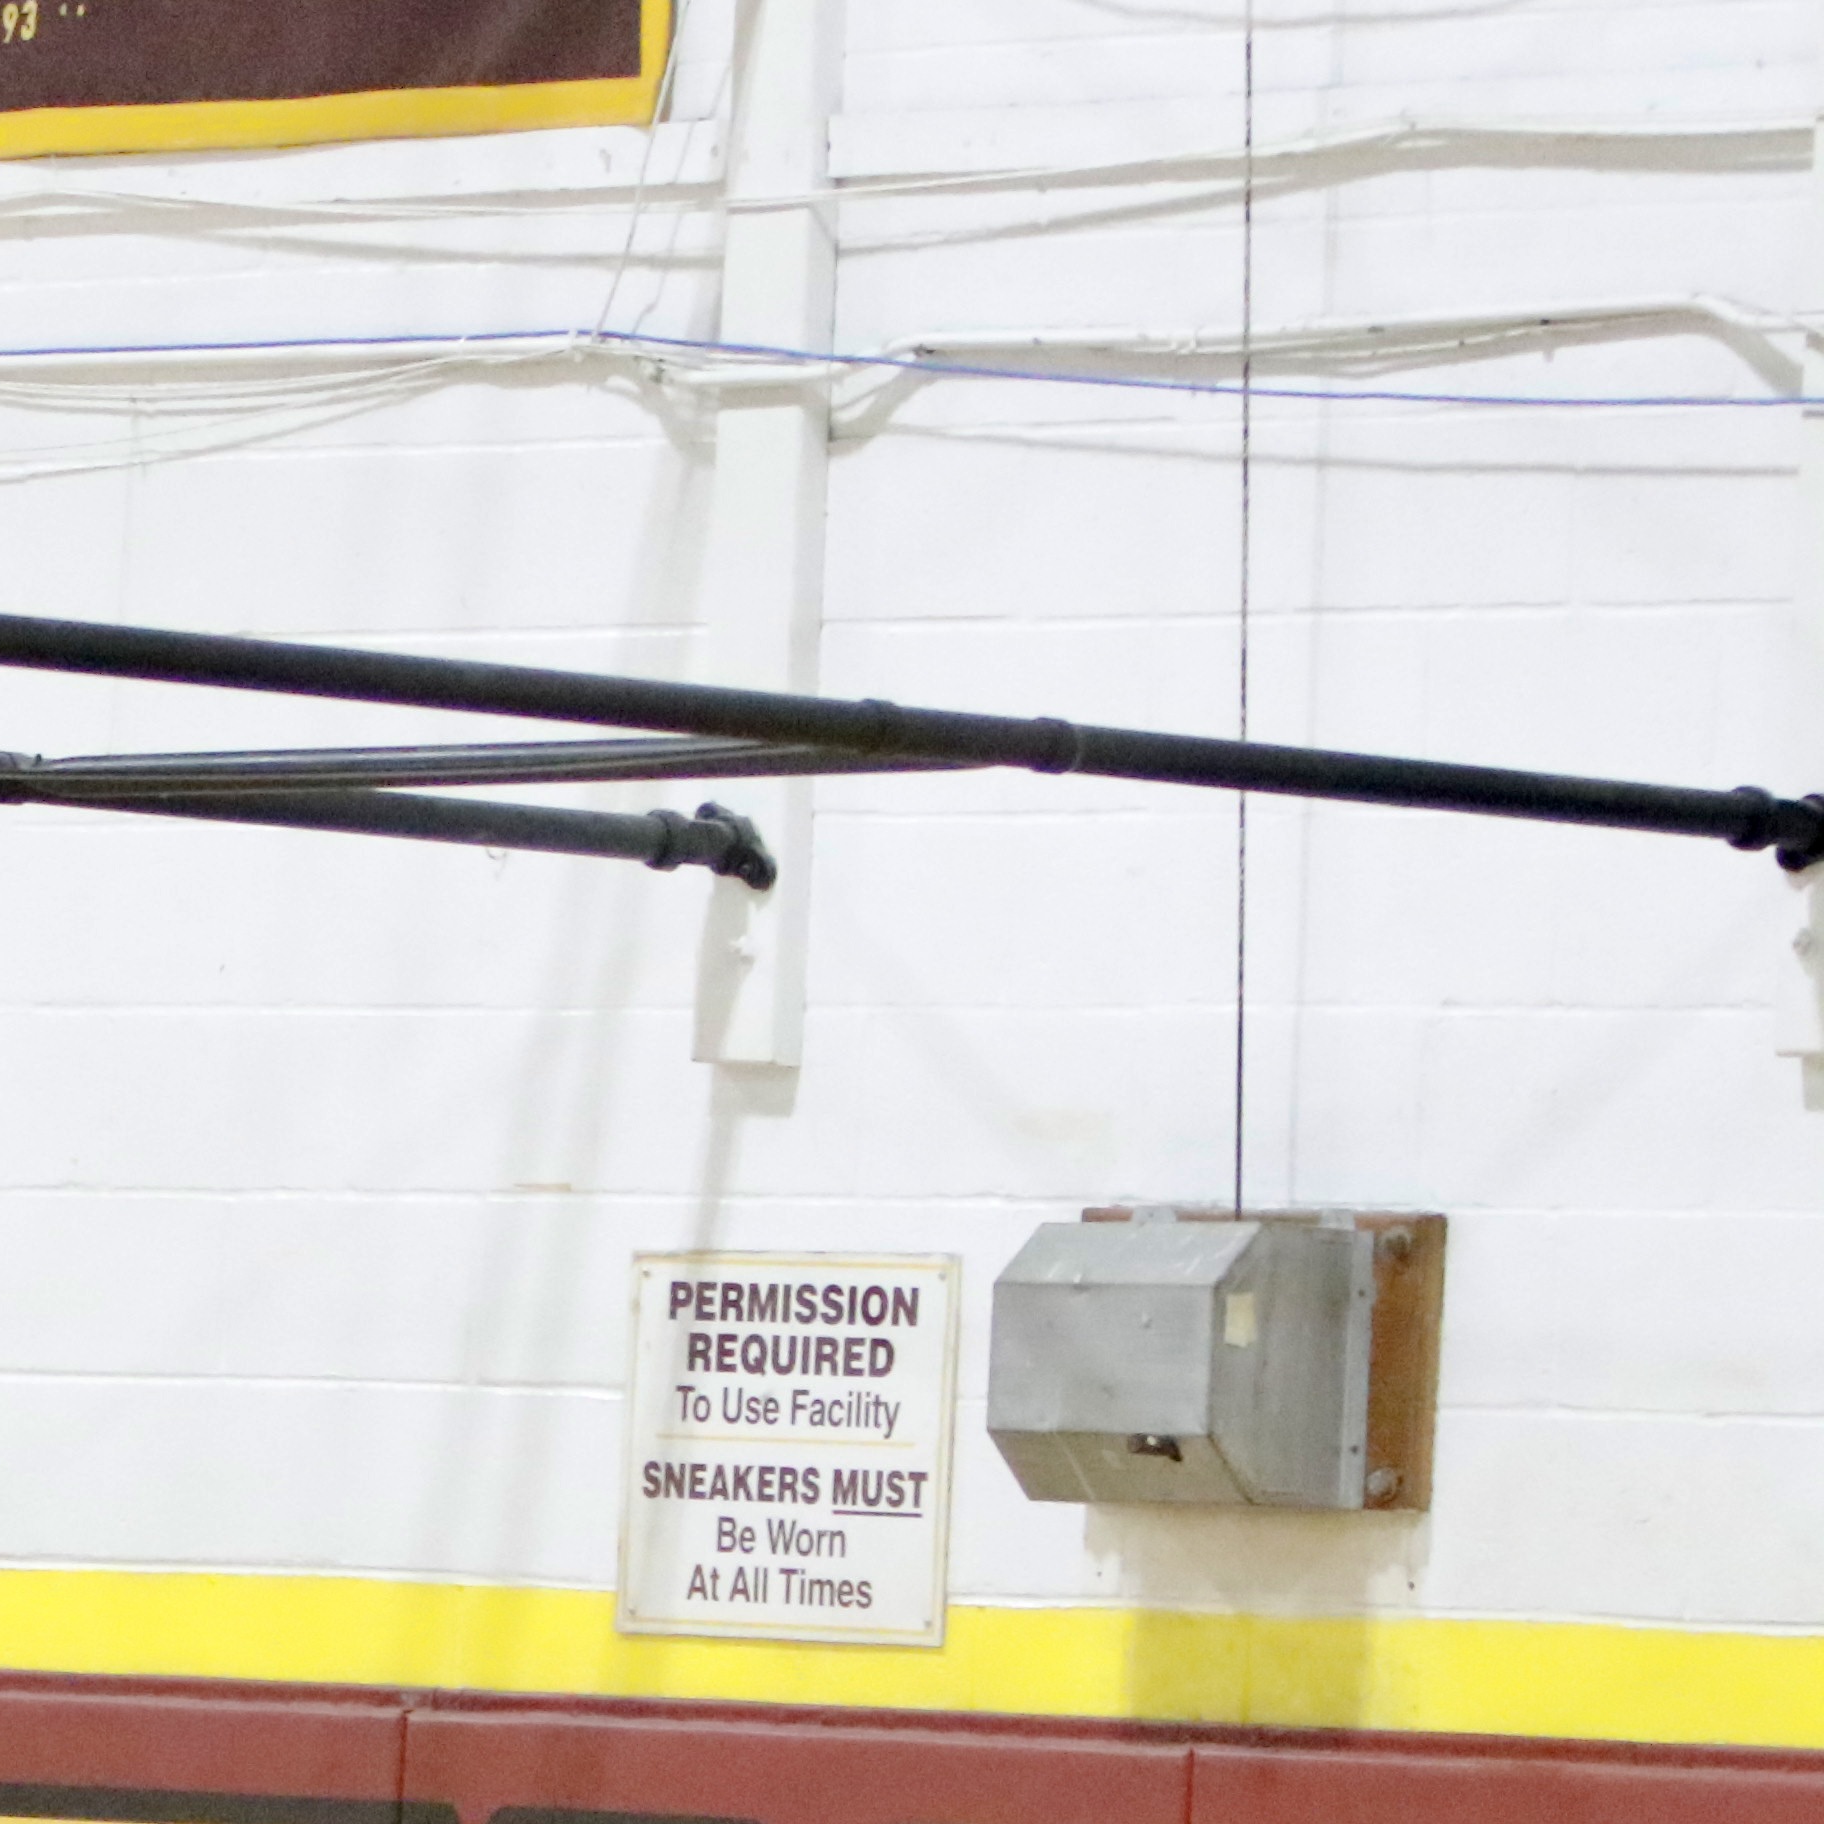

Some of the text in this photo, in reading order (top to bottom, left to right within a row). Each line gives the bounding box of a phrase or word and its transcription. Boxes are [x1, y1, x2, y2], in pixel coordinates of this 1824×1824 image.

[1, 0, 38, 43] 93
[668, 1280, 920, 1327] PERMISSION
[687, 1332, 896, 1378] REQUIRED
[676, 1385, 901, 1439] To Use Facility
[642, 1460, 929, 1510] SNEAKERS MUST
[717, 1515, 846, 1558] Be Worn
[687, 1563, 873, 1609] At All Times
